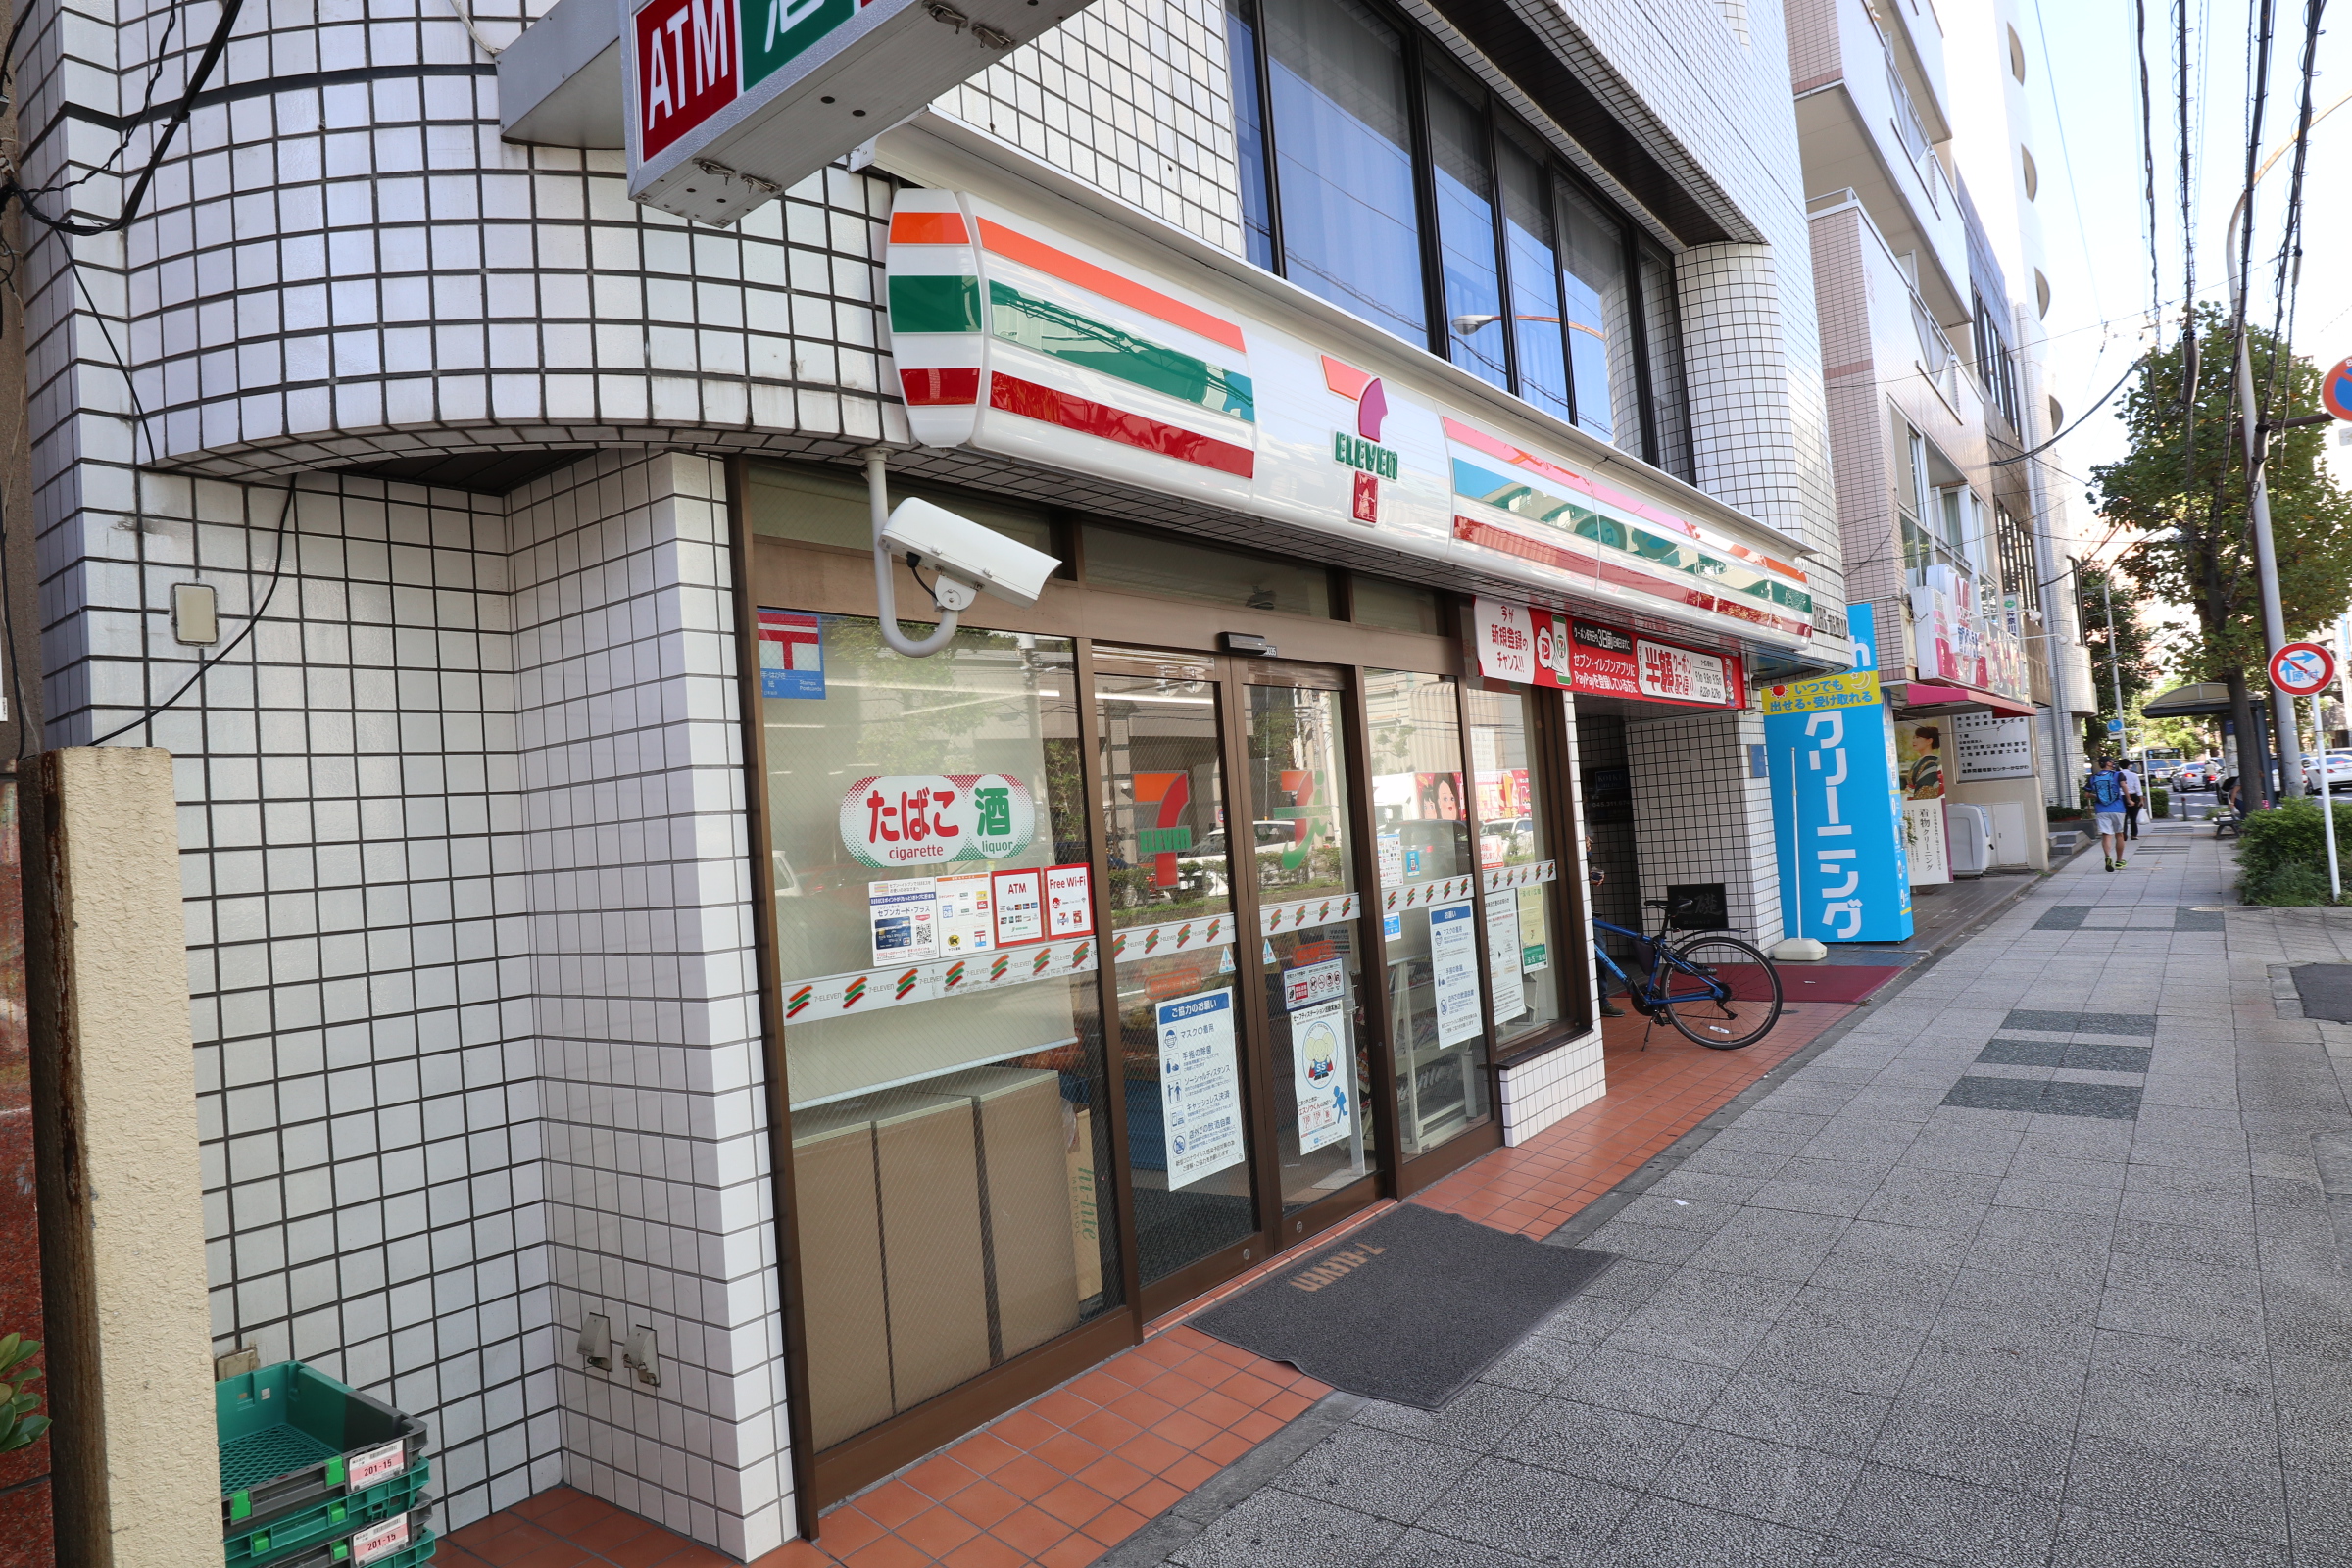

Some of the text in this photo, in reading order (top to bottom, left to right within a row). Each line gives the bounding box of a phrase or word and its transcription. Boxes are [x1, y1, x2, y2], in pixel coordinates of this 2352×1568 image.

[648, 4, 728, 130] ATM
[1500, 605, 1514, 623] 今が
[1491, 624, 1529, 651] 新規登録の
[1645, 647, 1674, 694] 半額
[1673, 653, 1692, 674] クーポン
[2293, 669, 2320, 682] 原付
[1794, 679, 1844, 694] いつでも
[1770, 691, 1873, 712] 出せる・受け取れる
[867, 786, 1011, 844] たばこ 酒
[1804, 710, 1863, 939] クリーニング
[1919, 808, 1934, 872] 着物クリーニング
[889, 840, 1013, 861] cigarette liquor
[1007, 883, 1026, 894] ATM
[1050, 876, 1086, 889] Free Wi-Fi
[878, 906, 931, 917] セブンカード・プラス
[1445, 910, 1457, 919] お願い
[1443, 925, 1463, 936] マスクの着用
[1171, 1000, 1217, 1017] ご協力のお願い
[1181, 1023, 1214, 1039] マスクの着用
[1182, 1045, 1212, 1060] 手指の除菌
[1184, 1064, 1231, 1085] ソーシャルディスタンス
[1316, 1062, 1326, 1072] SS
[1187, 1090, 1230, 1111] キャッシュレス決済
[1189, 1116, 1231, 1139] 店外での飲酒自粛
[364, 1458, 392, 1477] 201-15
[368, 1533, 396, 1551] 201-15
